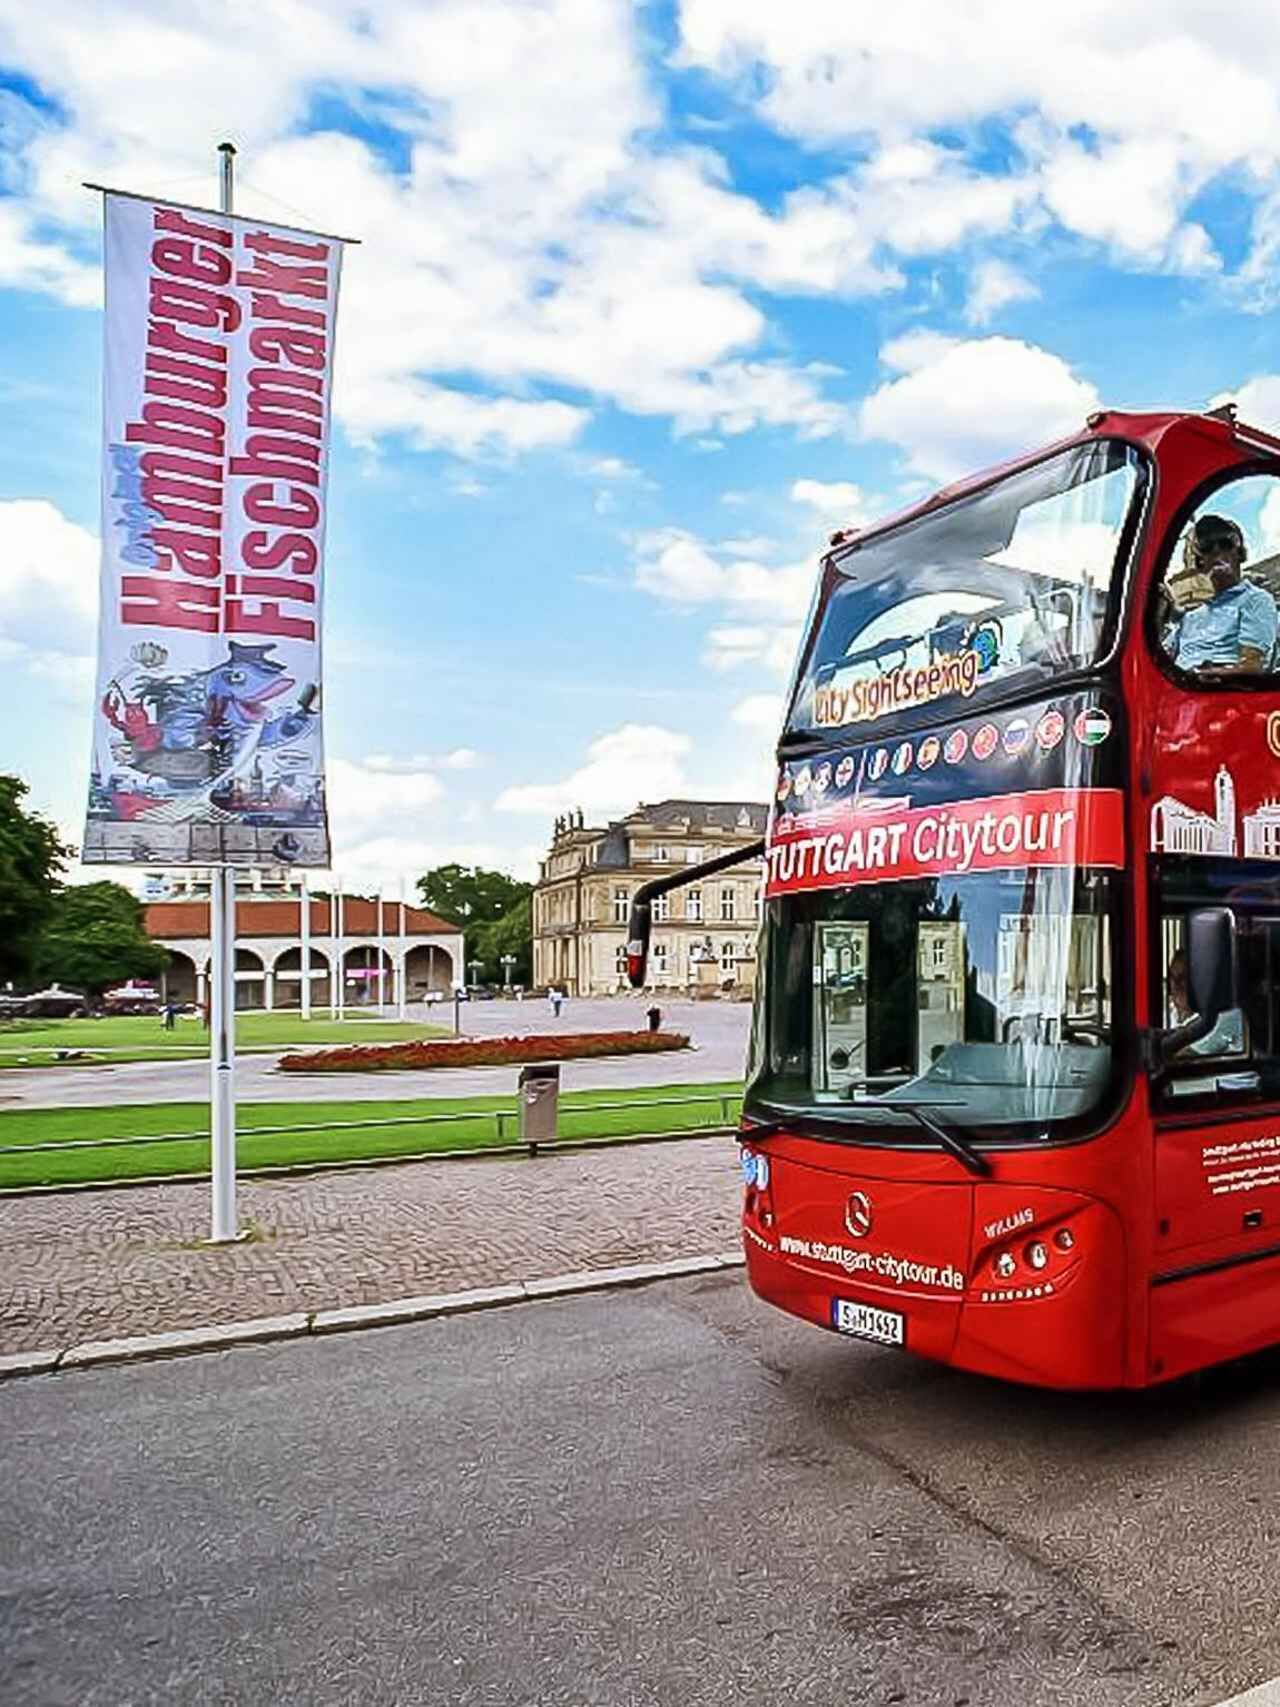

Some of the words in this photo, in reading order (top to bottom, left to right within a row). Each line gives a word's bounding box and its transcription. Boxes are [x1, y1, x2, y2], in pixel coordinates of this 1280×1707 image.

[121, 206, 242, 637] Hamburger
[224, 228, 331, 643] Fischmarkt
[850, 650, 978, 717] Sightseeing
[913, 809, 1075, 871] Citytour
[780, 1236, 963, 1290] www.stuttgart-citytour.de
